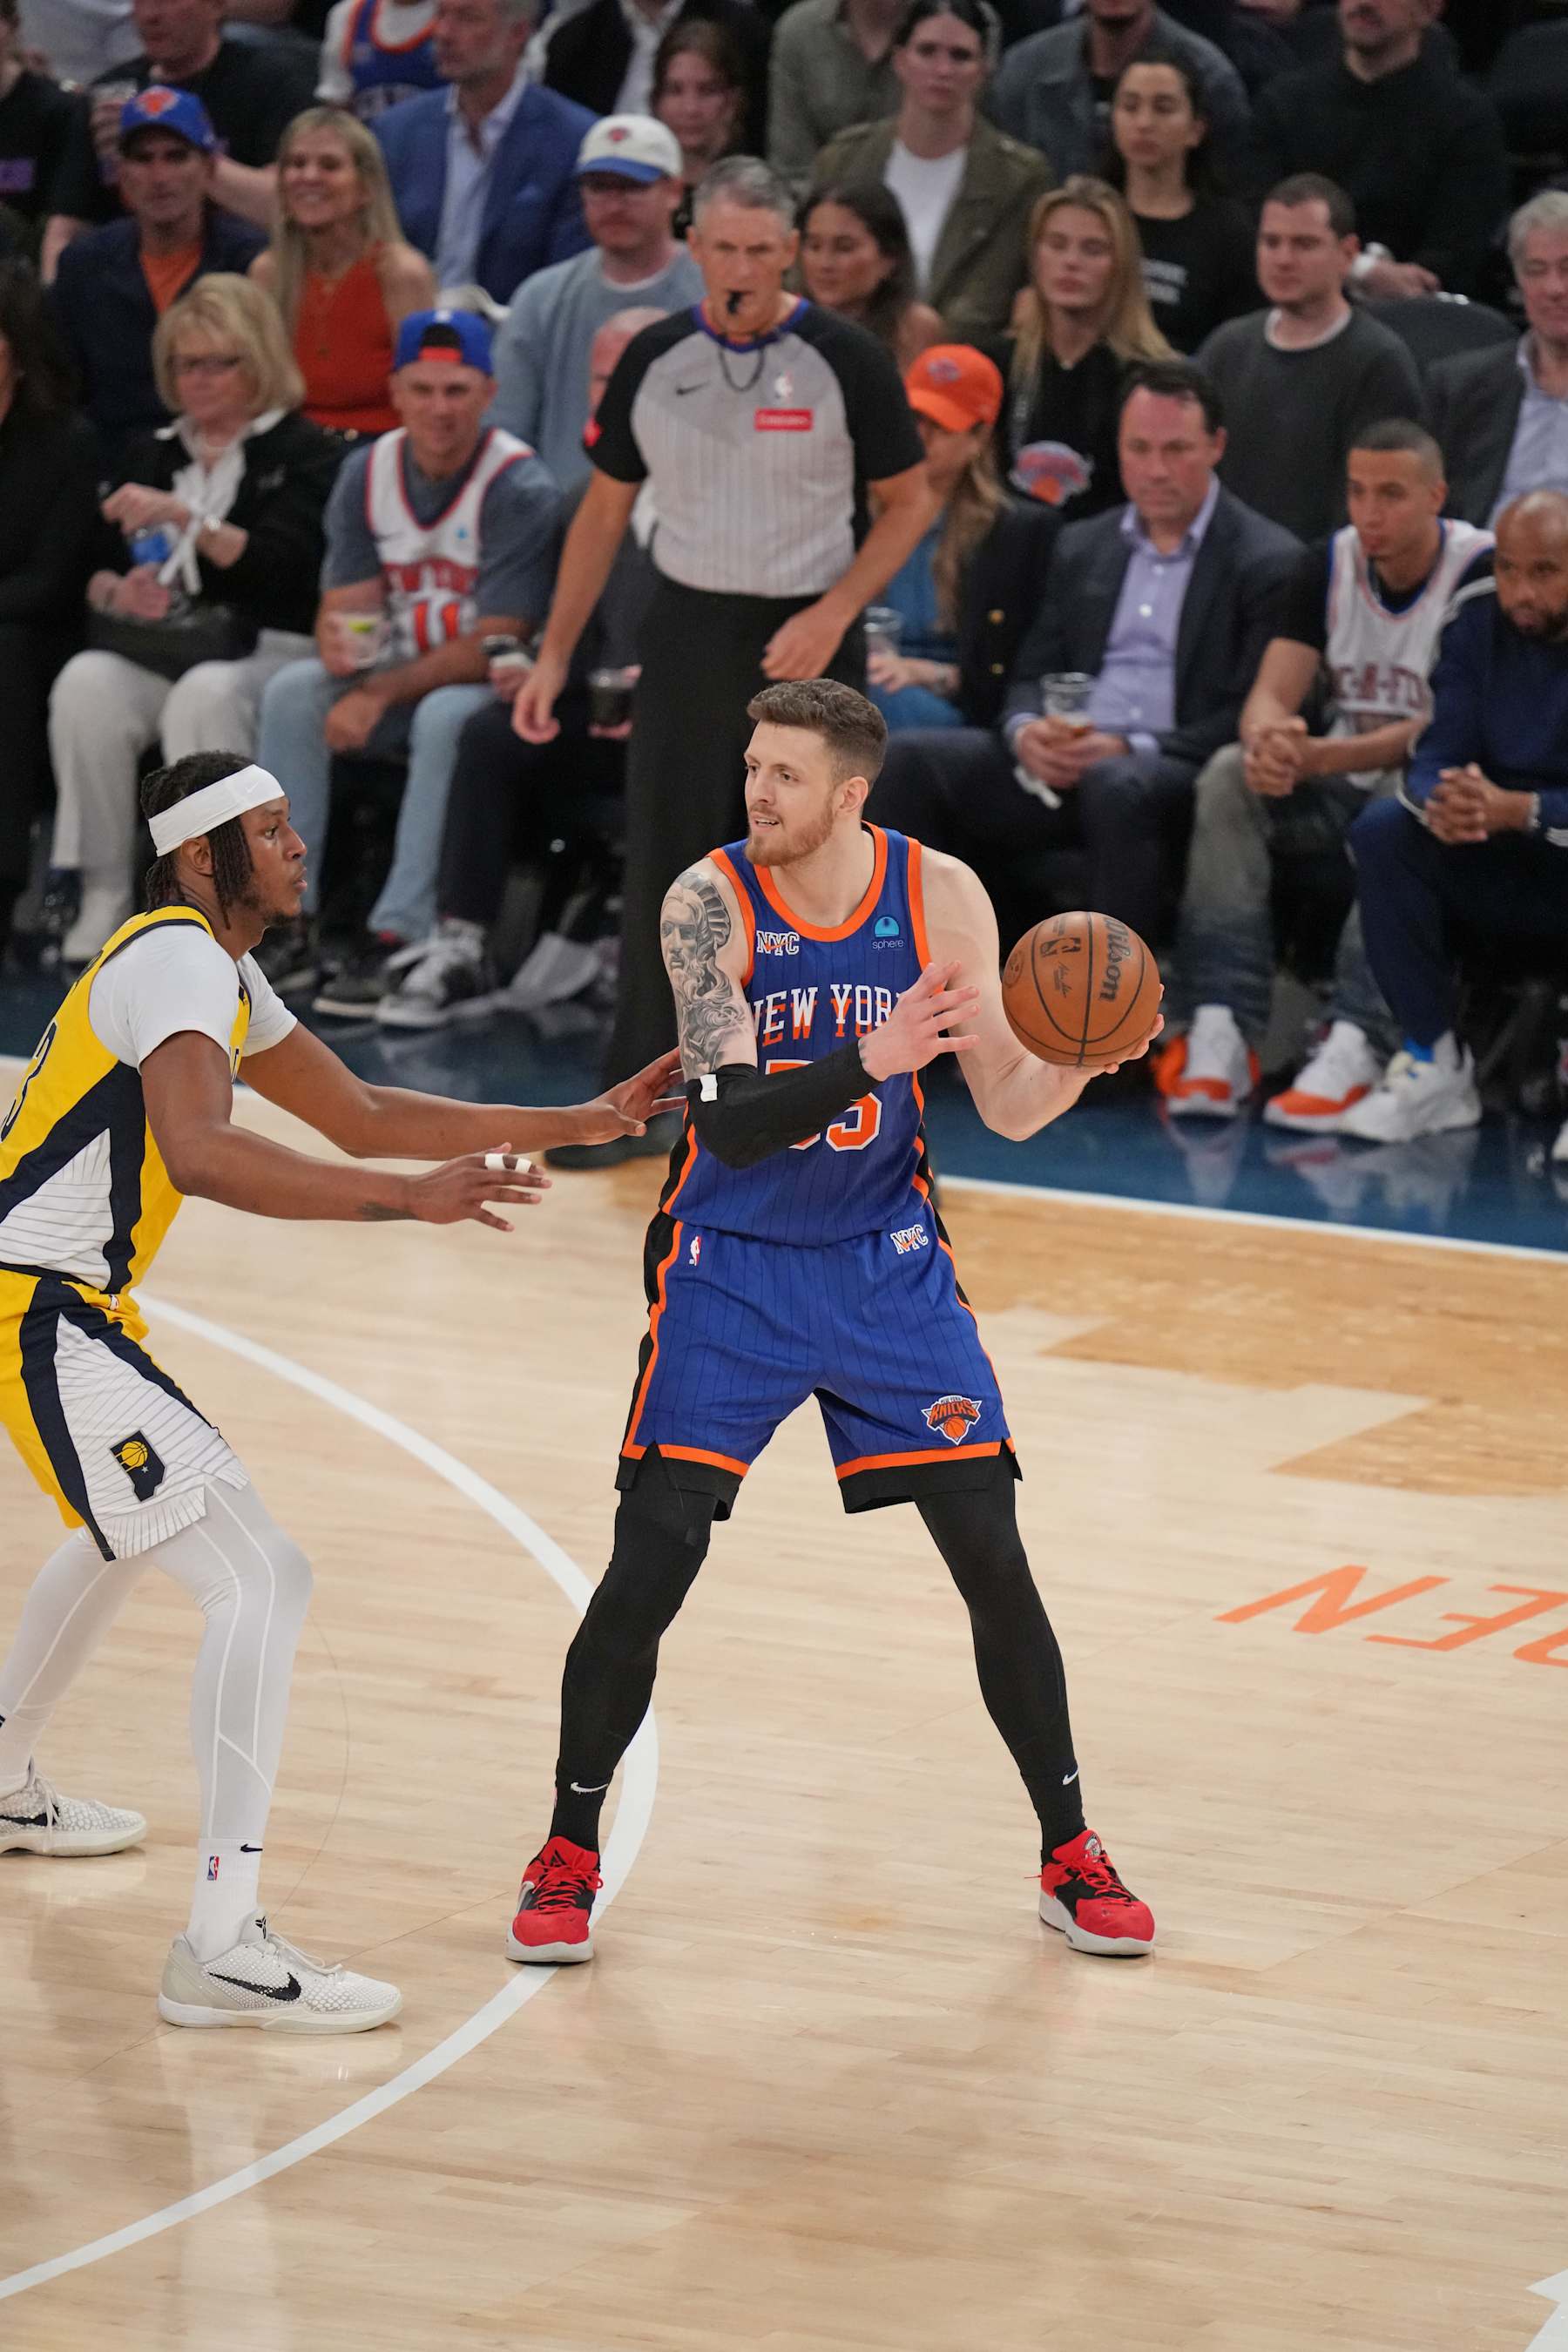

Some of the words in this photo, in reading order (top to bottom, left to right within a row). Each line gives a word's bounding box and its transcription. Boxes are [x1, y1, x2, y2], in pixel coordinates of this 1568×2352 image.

[756, 930, 800, 956] NYC
[872, 939, 904, 950] sphere
[1100, 916, 1131, 1002] Wilson
[830, 983, 901, 1037] YOR
[765, 1059, 882, 1152] 5
[890, 1224, 929, 1254] NYC
[929, 1399, 978, 1425] KNICKS
